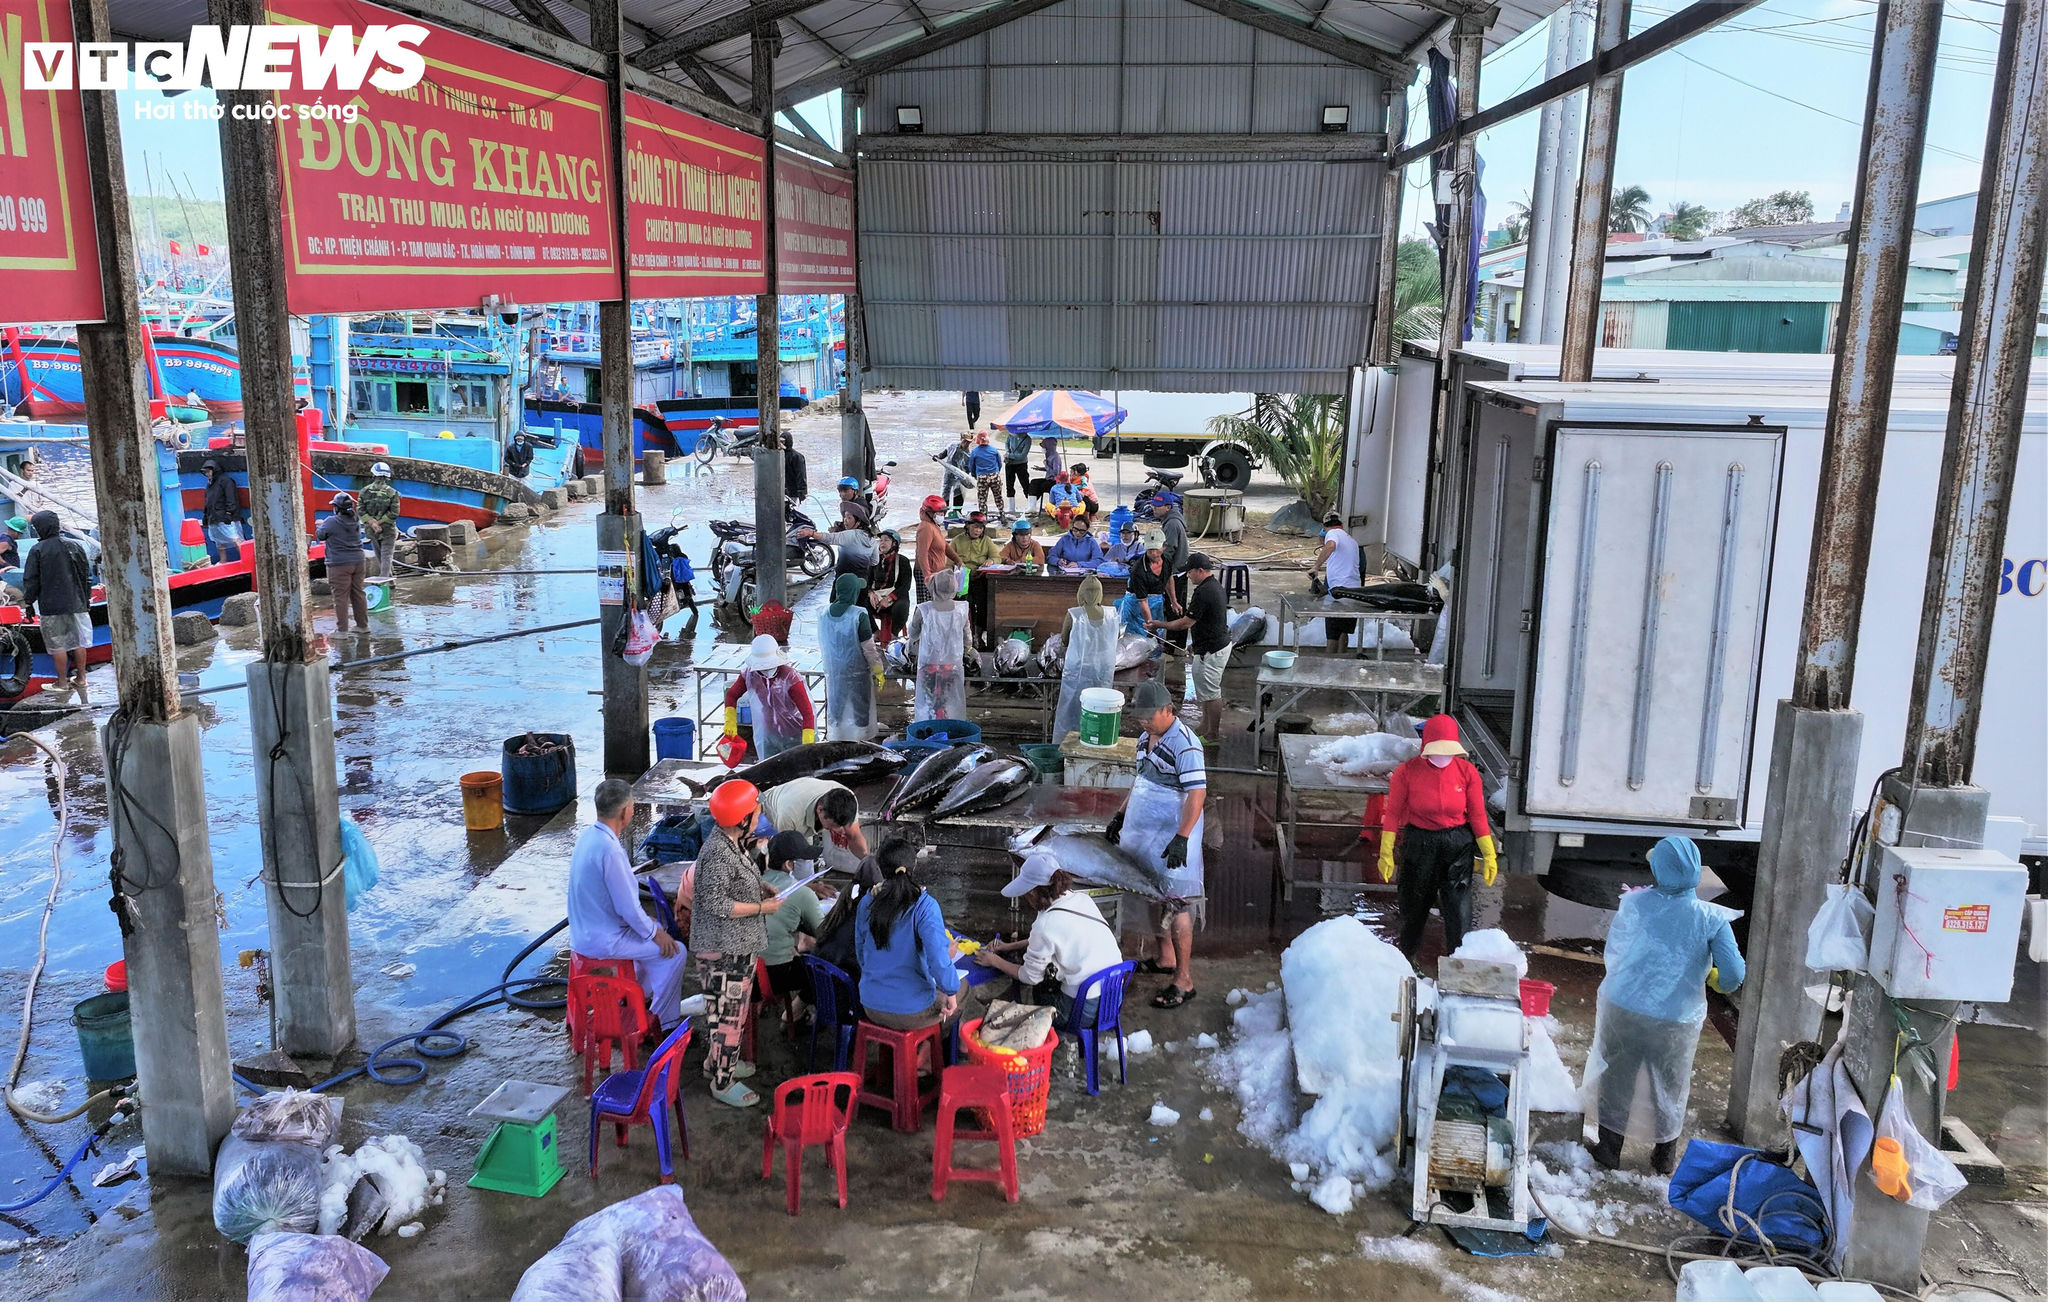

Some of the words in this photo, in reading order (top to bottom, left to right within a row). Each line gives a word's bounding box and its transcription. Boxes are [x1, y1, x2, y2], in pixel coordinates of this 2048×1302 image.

[421, 80, 438, 106] TY
[442, 85, 478, 116] TNHH
[480, 95, 498, 119] SX
[508, 102, 526, 125] TM
[529, 107, 537, 129] &
[540, 109, 553, 131] DV
[292, 95, 456, 187] ĐÔNG
[468, 137, 602, 204] KHANG
[627, 140, 663, 206] CÔNG
[664, 158, 678, 208] TY
[680, 162, 708, 213] TNHH
[710, 155, 726, 216] HẢI
[19, 196, 48, 233] 999
[338, 193, 386, 229] TRẠI
[389, 197, 425, 226] THU
[430, 201, 467, 230] MUA
[470, 202, 492, 231] CÁ
[494, 205, 524, 233] NGỪ
[526, 211, 548, 238] ĐẠI
[551, 212, 590, 236] DƯƠNG
[645, 215, 674, 243] CHUYÊN
[674, 221, 688, 244] THU
[324, 237, 338, 255] KP.
[338, 234, 363, 259] THIỆN
[364, 236, 390, 257] CHÁNH
[390, 240, 396, 256] 1
[408, 241, 424, 257] TAM
